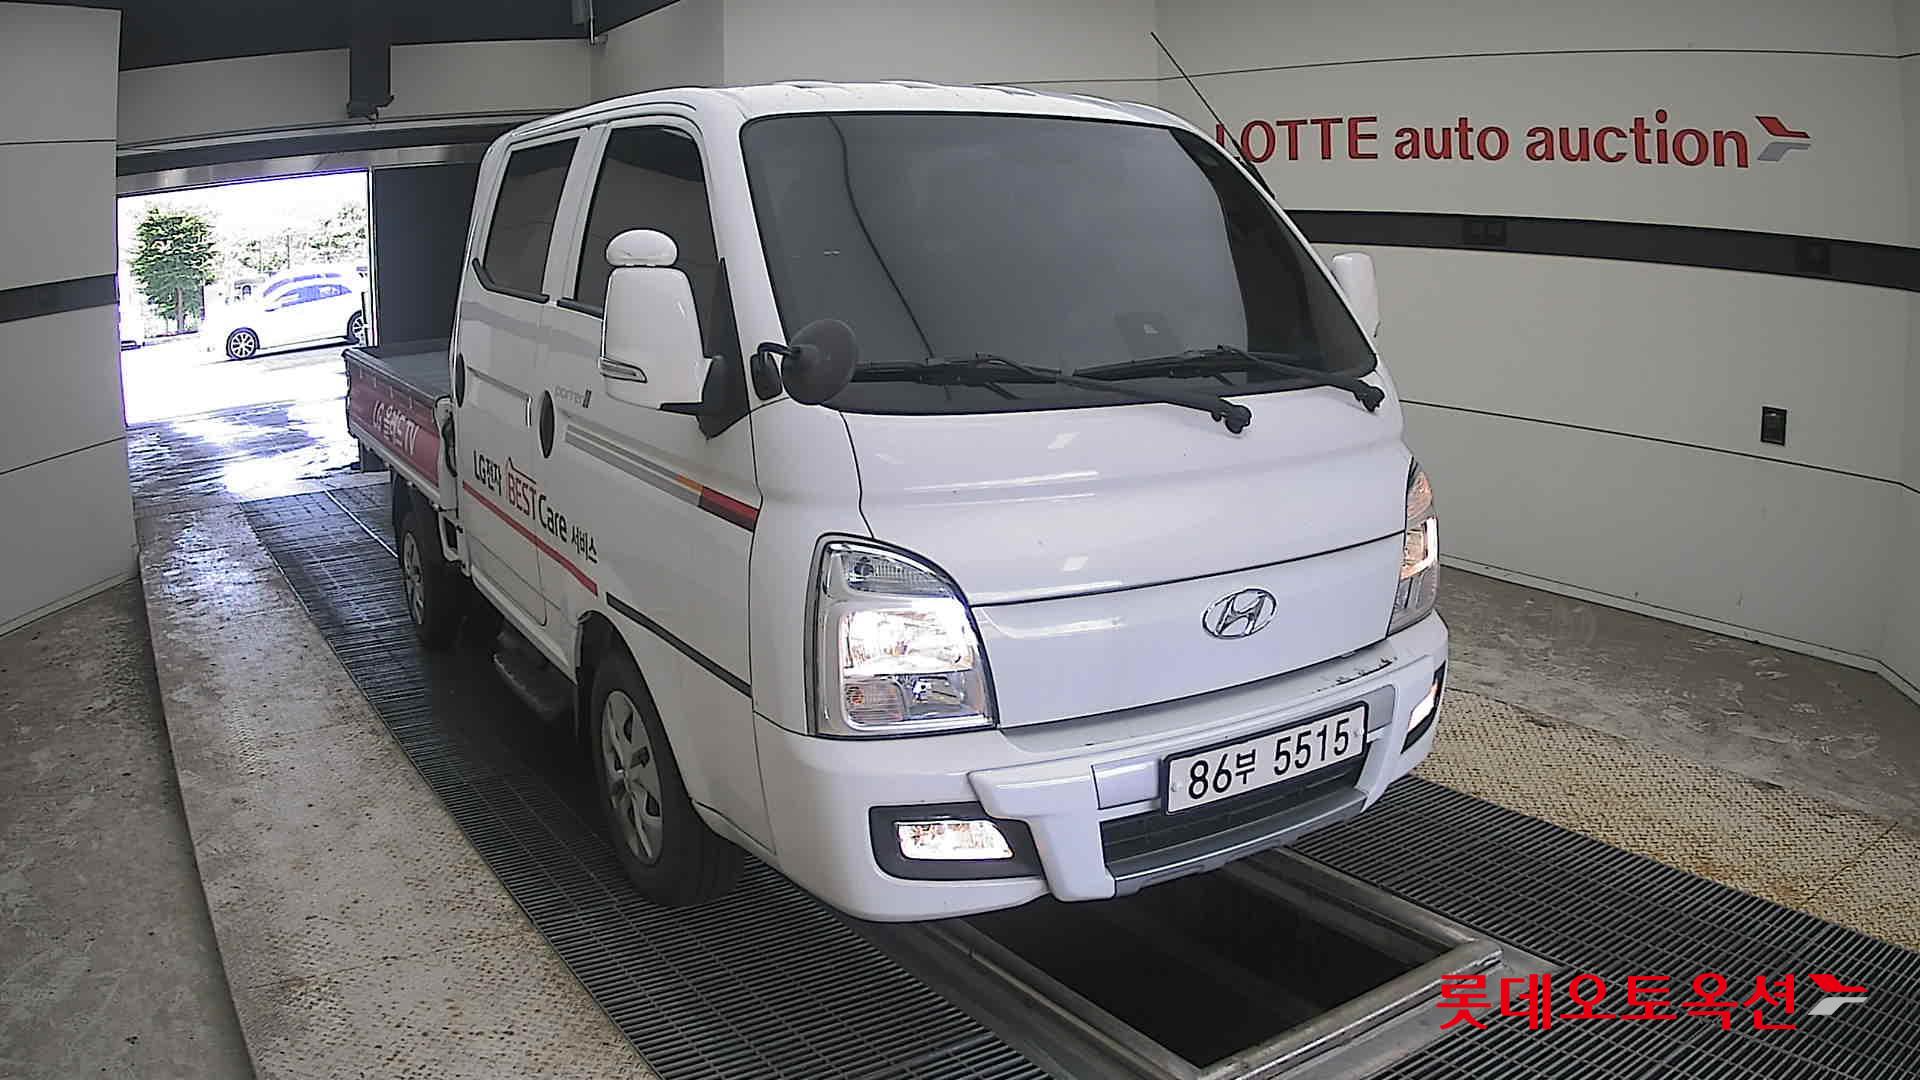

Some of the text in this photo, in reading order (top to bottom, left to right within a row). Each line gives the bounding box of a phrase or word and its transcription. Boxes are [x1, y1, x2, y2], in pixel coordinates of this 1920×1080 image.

[1394, 116, 1510, 161] auto
[1525, 108, 1750, 169] auction
[508, 471, 538, 521] BEST
[538, 494, 568, 543] Care
[571, 524, 598, 564] 서비스
[1187, 717, 1350, 800] 86부 5515
